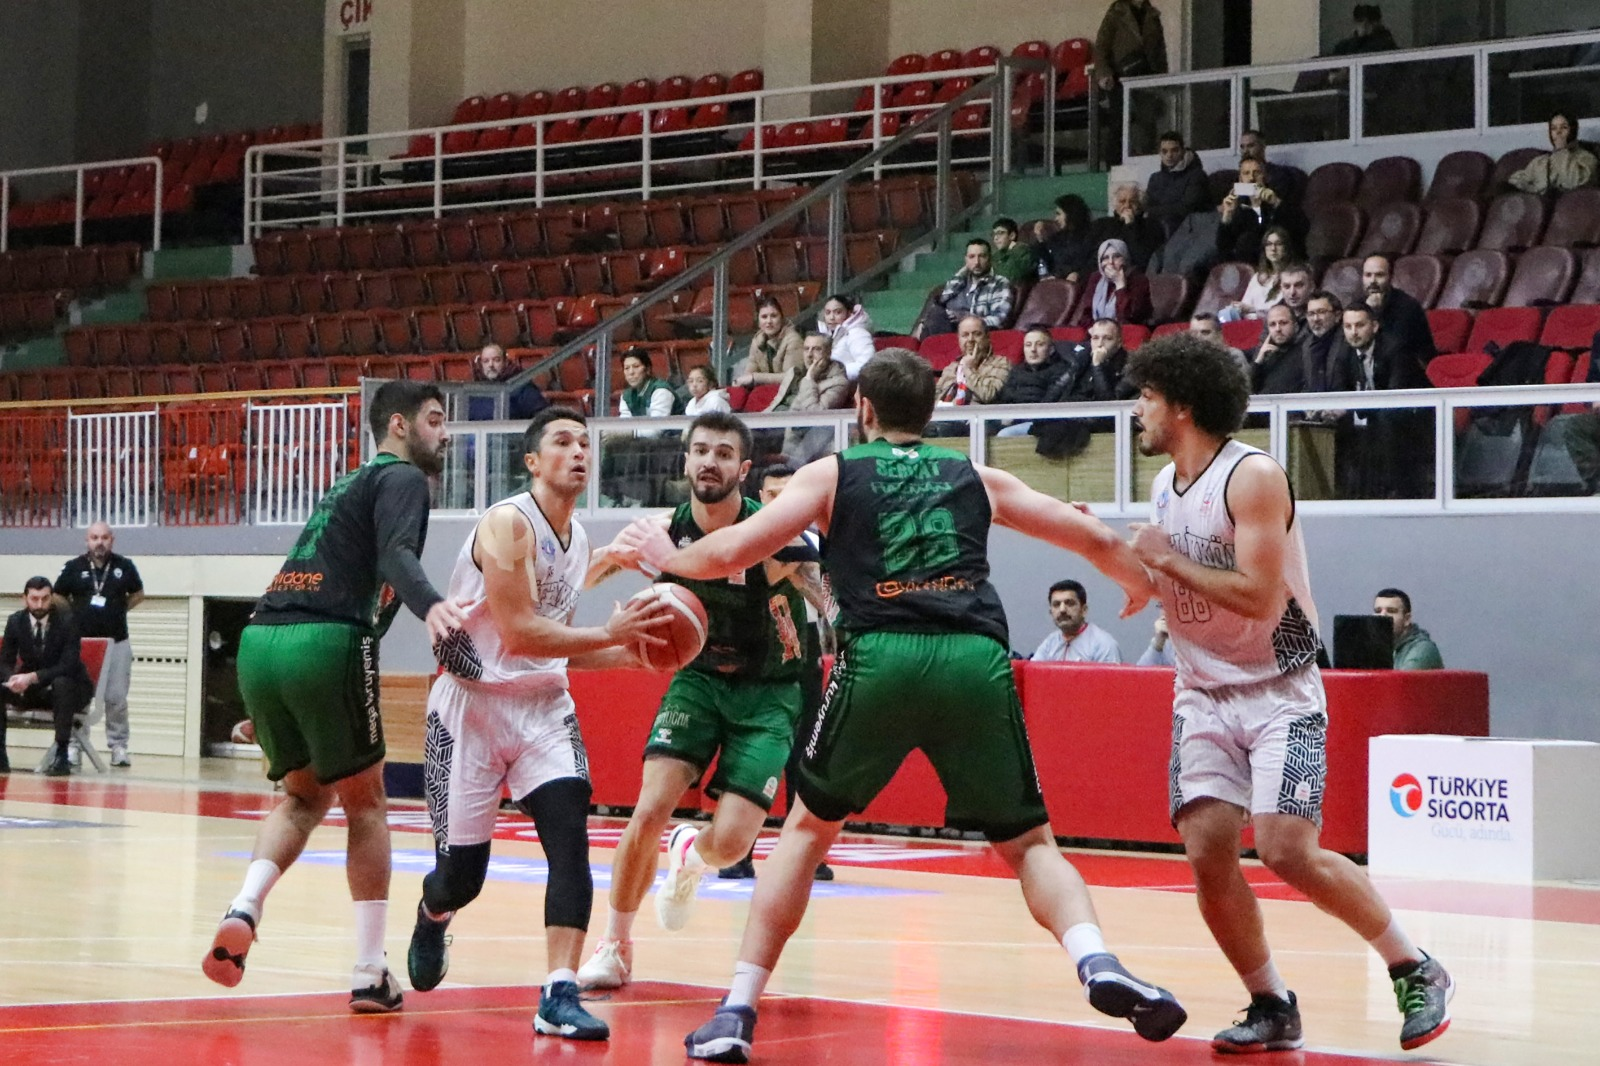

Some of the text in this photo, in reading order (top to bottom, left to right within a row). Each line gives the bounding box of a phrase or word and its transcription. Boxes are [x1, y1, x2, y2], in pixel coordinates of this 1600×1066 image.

[368, 705, 379, 744] mega
[805, 680, 839, 760] kuruyemiş
[1427, 775, 1508, 799] TÜRKİYE
[1427, 798, 1510, 823] SİGORTA
